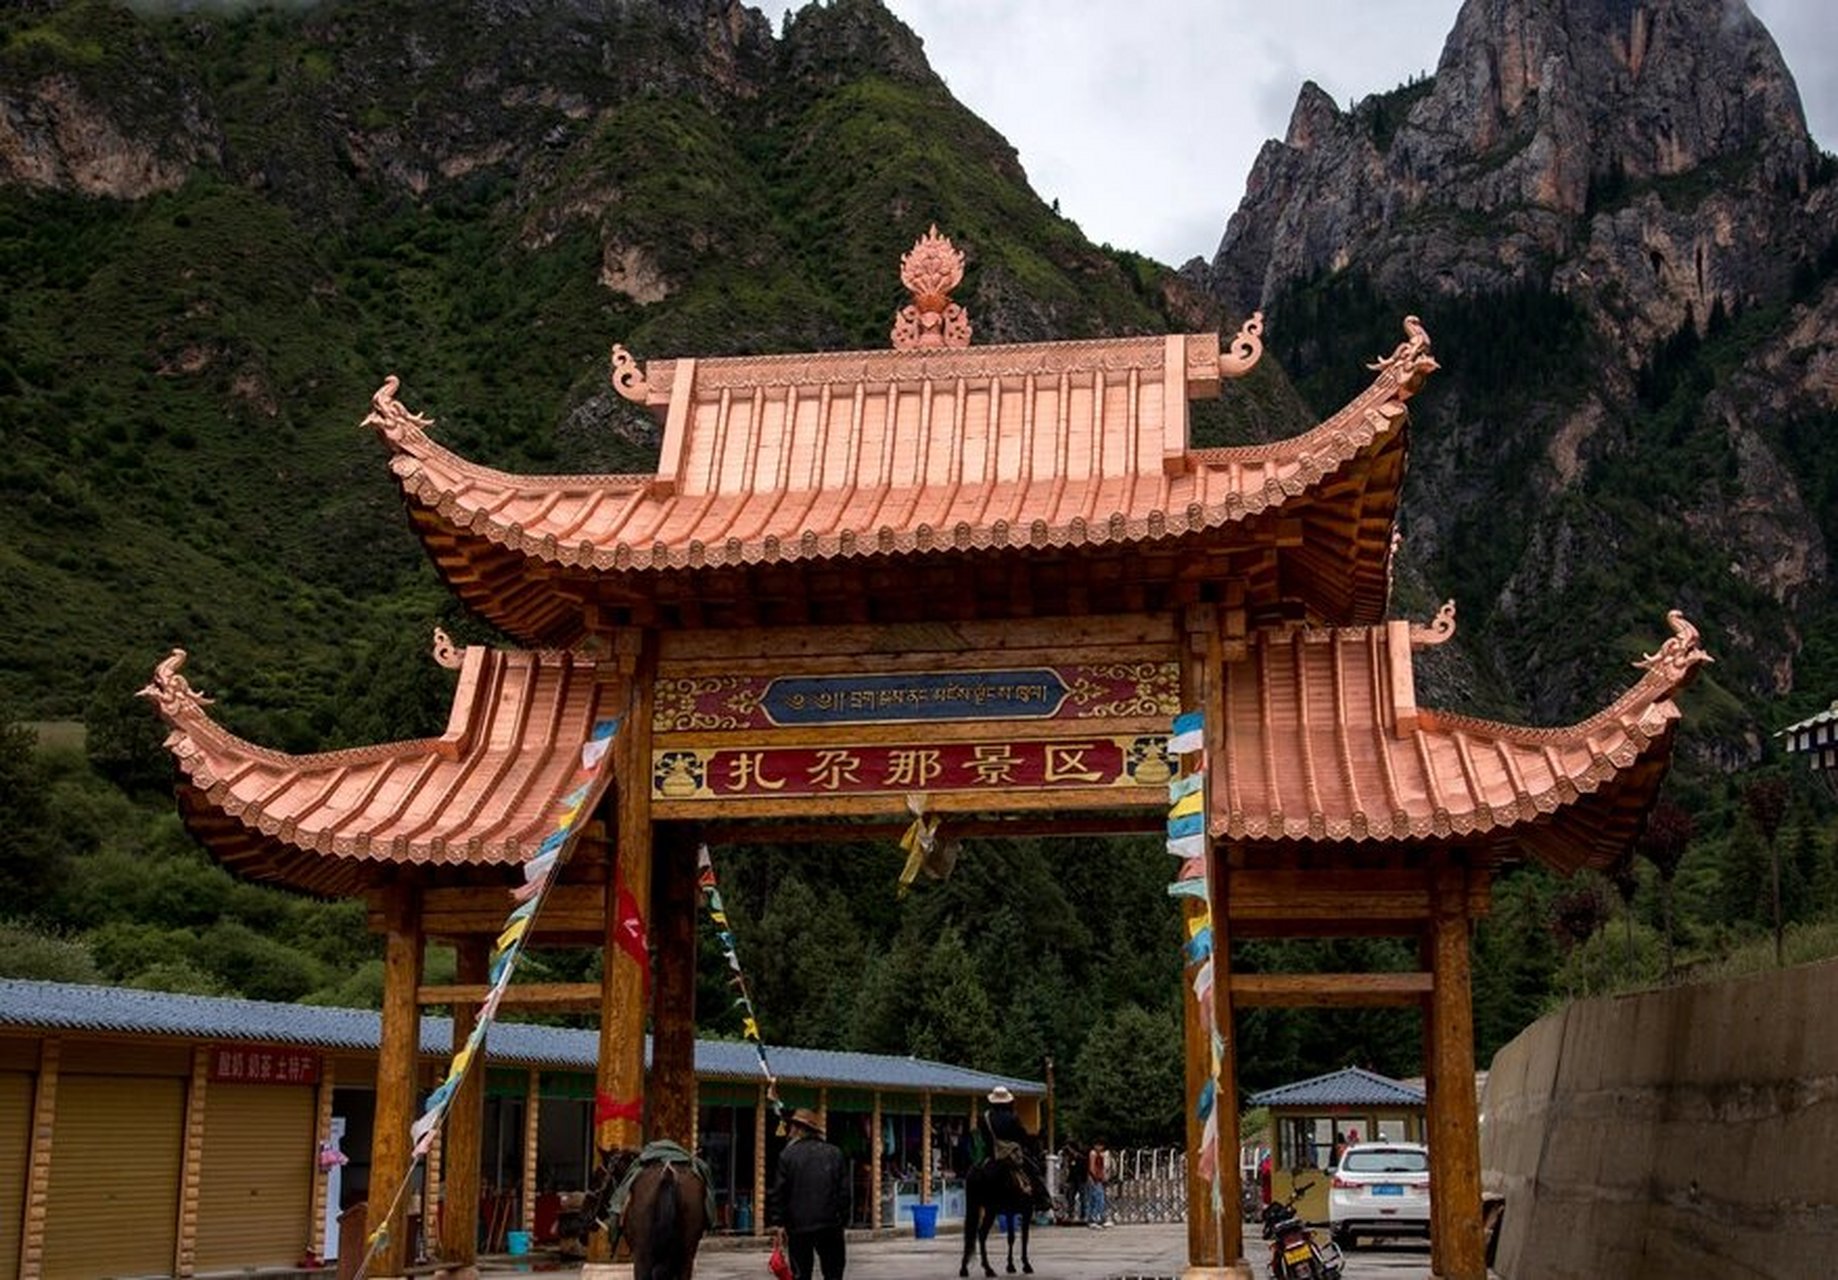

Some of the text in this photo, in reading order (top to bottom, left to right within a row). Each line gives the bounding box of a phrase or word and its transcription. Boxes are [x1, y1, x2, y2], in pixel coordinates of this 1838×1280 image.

[728, 745, 1104, 790] 扎尕那景区
[248, 1053, 272, 1080] 奶茶
[275, 1055, 313, 1080] 土特产
